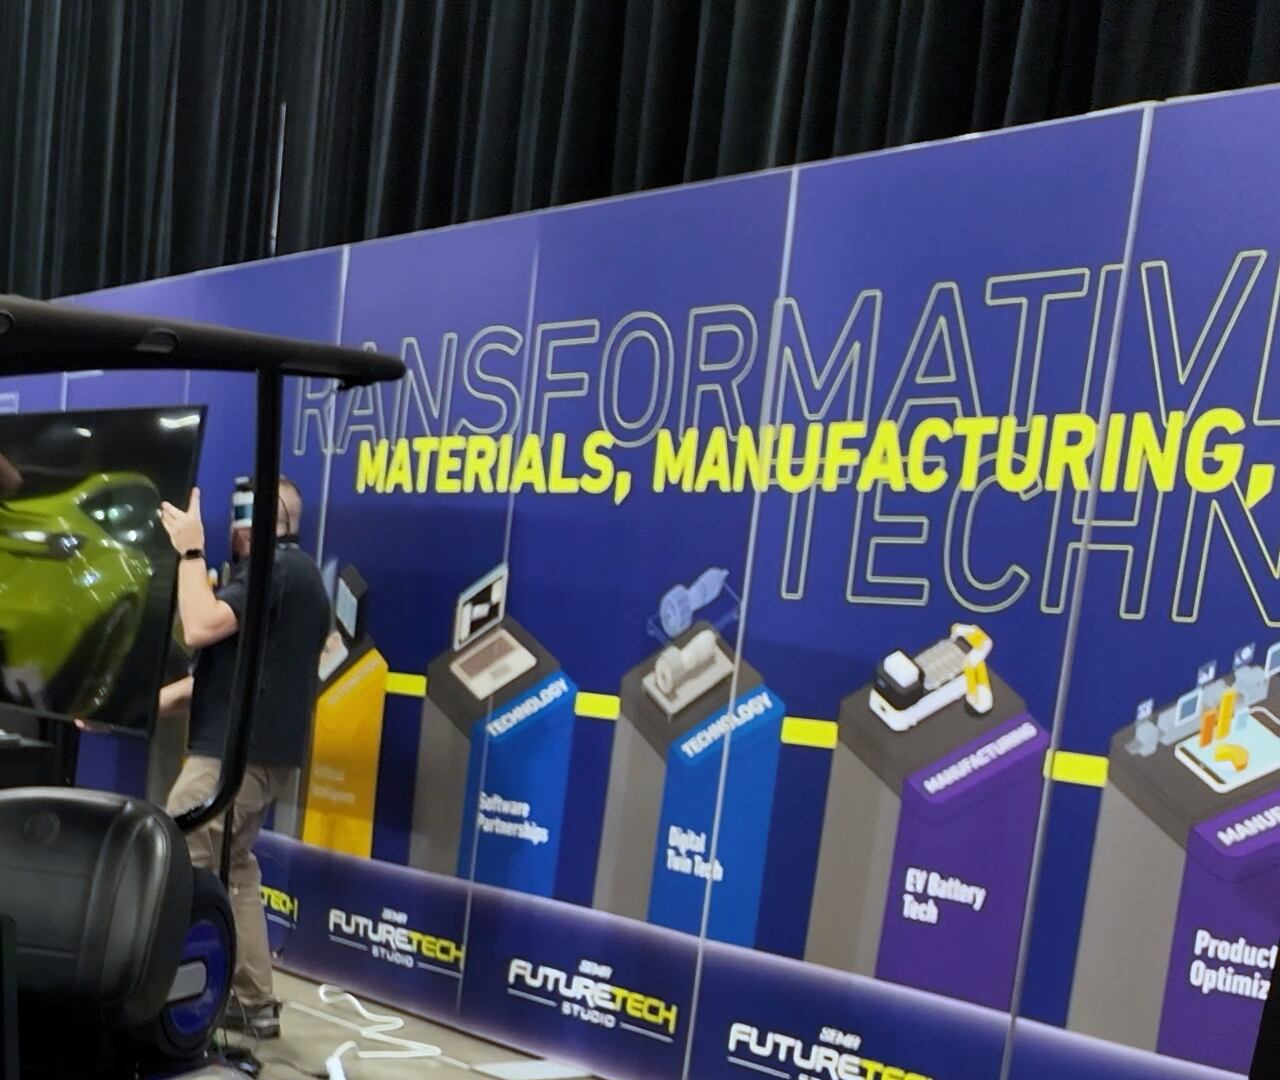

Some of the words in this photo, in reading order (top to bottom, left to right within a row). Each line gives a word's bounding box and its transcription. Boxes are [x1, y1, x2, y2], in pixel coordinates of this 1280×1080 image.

[293, 249, 1280, 455] RANSFORMATIV
[356, 429, 631, 505] MATERIALS,
[652, 408, 1276, 509] MANUFACTURING,
[486, 677, 569, 737] TECHNOLOGY
[680, 691, 774, 758] TECHNOLOGY
[923, 721, 1038, 794] MANUFACTURING
[478, 791, 531, 818] Software
[477, 812, 549, 845] Partnerships
[668, 825, 707, 858] Digital
[693, 855, 725, 881] Tech
[905, 867, 928, 893] EV
[927, 871, 987, 911] Battery
[902, 893, 939, 924] Tech
[328, 908, 465, 972] FUTURETECH
[372, 944, 415, 968] STUDIO
[507, 958, 678, 1035] FUTURETECH
[1189, 959, 1271, 1001] Optimiz
[560, 1001, 617, 1028] STUDIO
